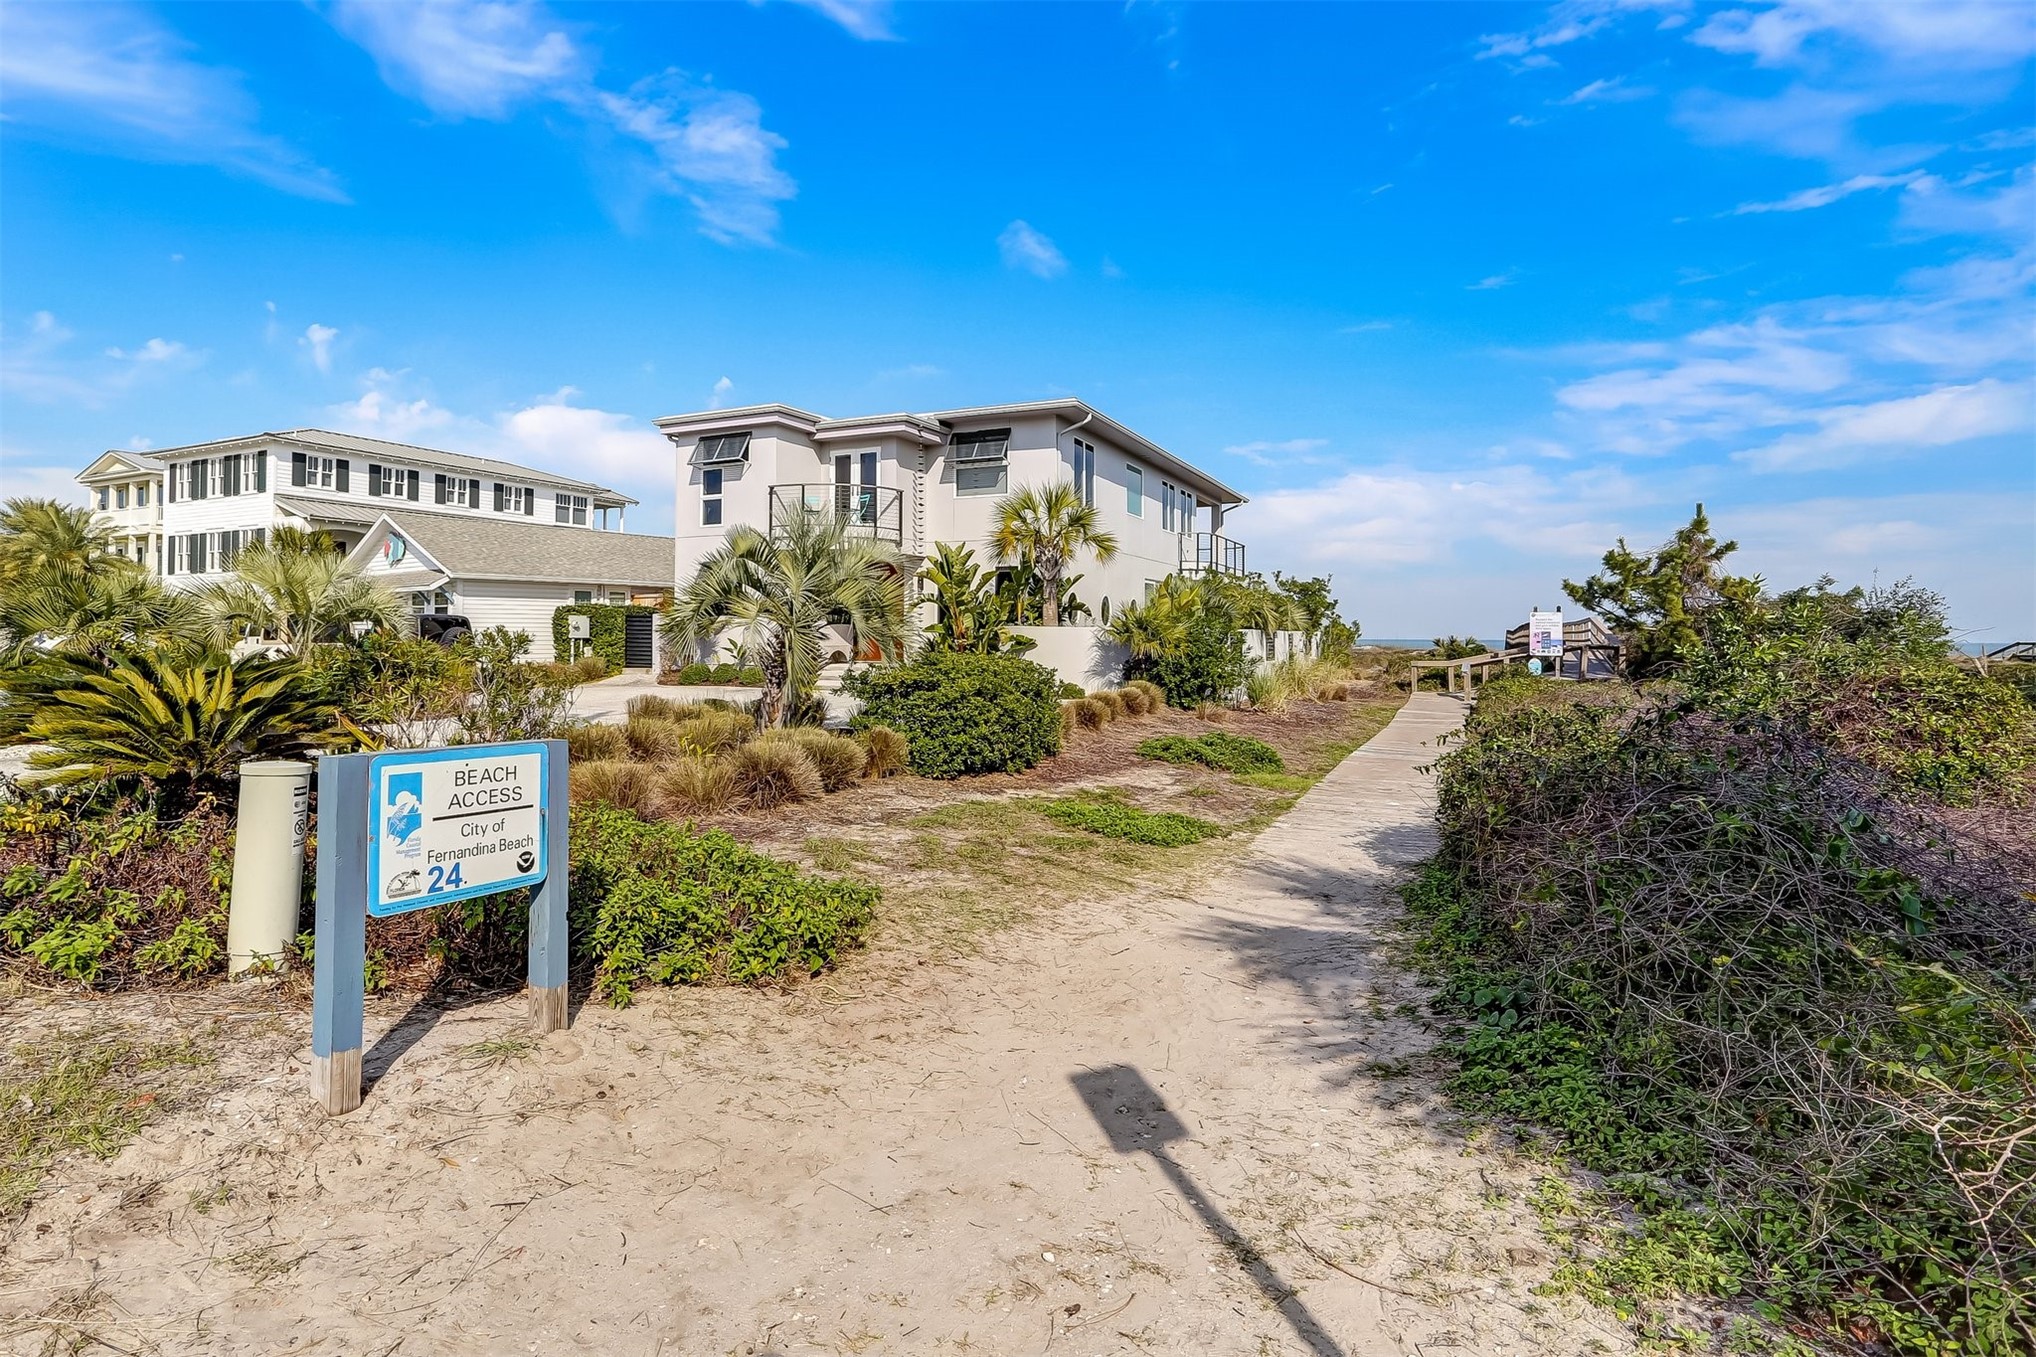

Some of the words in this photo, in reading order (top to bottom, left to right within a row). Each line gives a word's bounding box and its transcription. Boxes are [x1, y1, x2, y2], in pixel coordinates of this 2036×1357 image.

[454, 765, 518, 787] BEACH
[448, 785, 523, 810] ACCESS
[460, 821, 488, 838] City
[492, 818, 506, 833] of
[427, 842, 496, 864] Fernandina
[499, 834, 534, 852] Beach
[427, 862, 463, 894] 24
